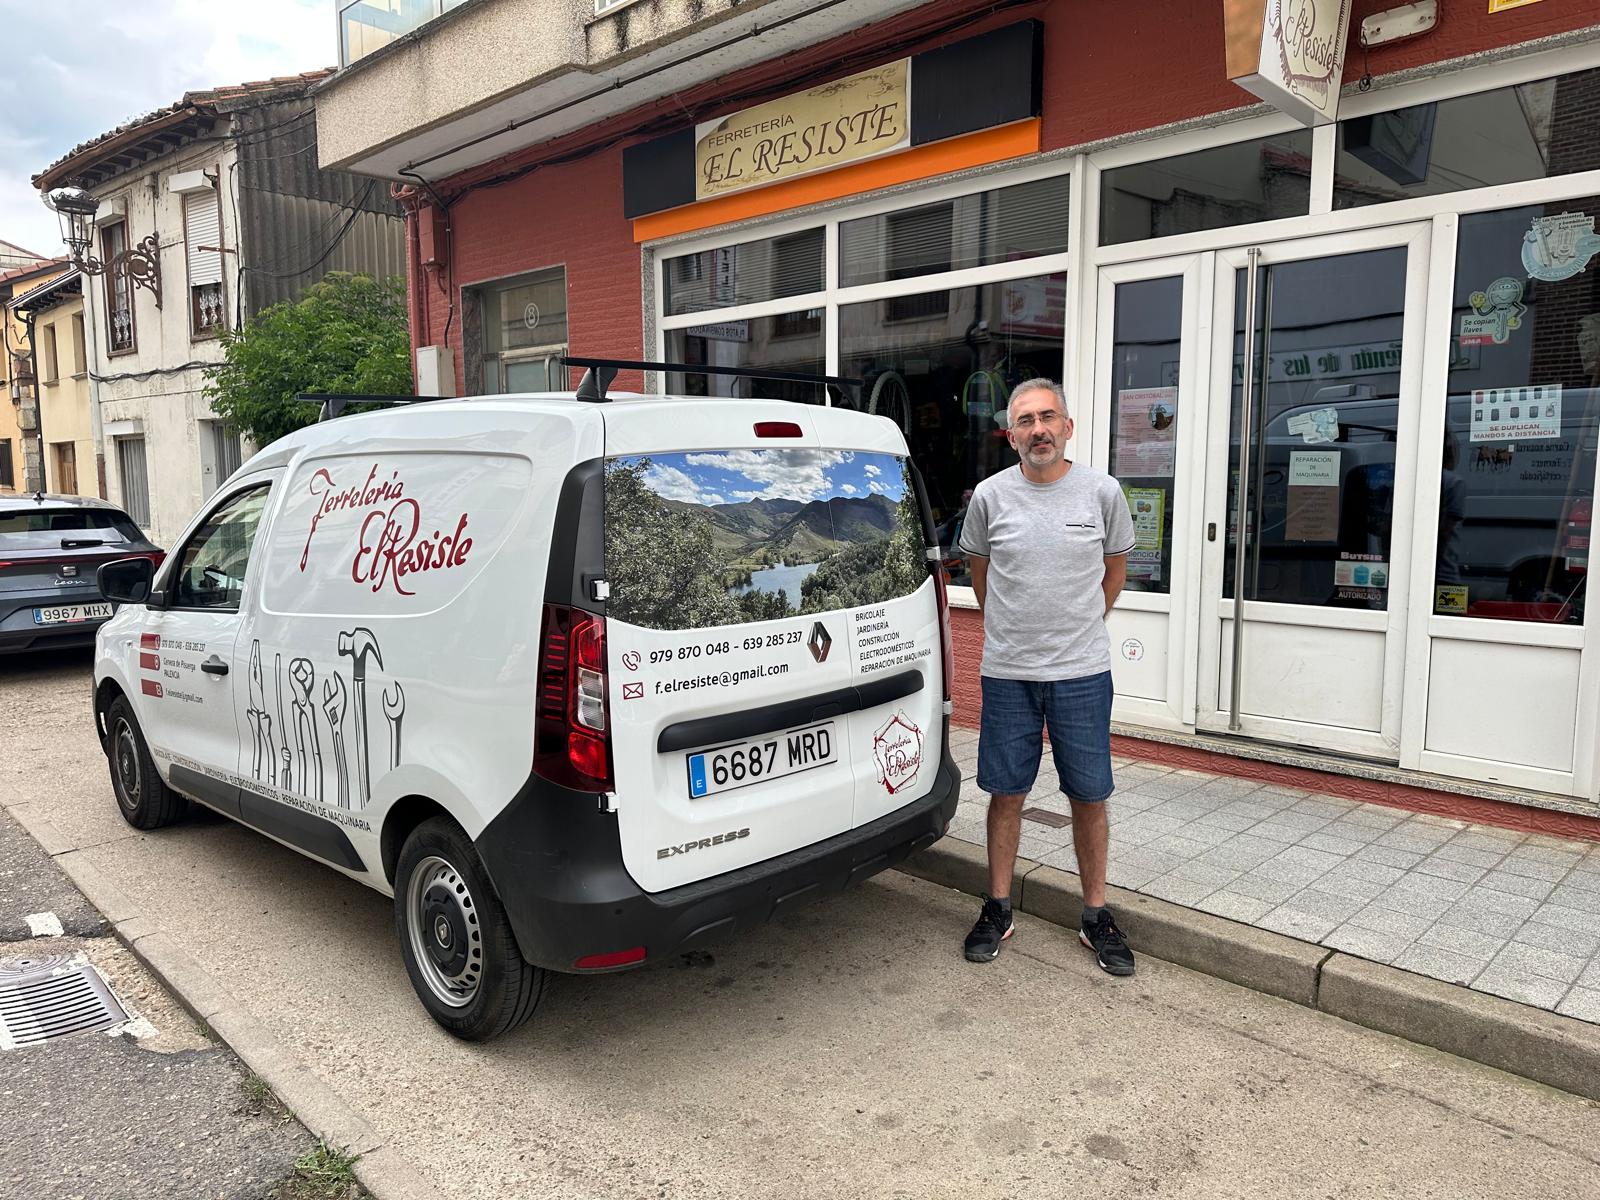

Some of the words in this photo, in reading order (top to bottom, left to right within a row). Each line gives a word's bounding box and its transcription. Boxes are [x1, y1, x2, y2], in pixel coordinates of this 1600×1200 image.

[708, 113, 795, 149] FERRETERÍA
[703, 148, 743, 186] EL
[752, 102, 899, 174] RESISTE
[527, 306, 537, 325] 8
[1473, 318, 1496, 327] copian
[1489, 424, 1500, 432] SE
[1500, 423, 1541, 432] DUPLICAN
[1514, 429, 1557, 437] DISTANCIA
[1295, 455, 1332, 463] REPARACIÓN
[371, 497, 474, 596] Resiste
[54, 578, 88, 587] Leon
[1338, 591, 1382, 601] AUTORIZADO
[43, 607, 79, 621] 9967
[83, 604, 110, 617] MHX
[855, 608, 886, 622] BRICOLAJE
[649, 648, 674, 664] 979
[677, 645, 702, 660] 870
[706, 641, 731, 657] 048
[743, 636, 765, 651] 639
[766, 633, 785, 648] 285
[786, 630, 803, 645] 237
[859, 640, 915, 661] ELECTRODOMÉSTICOS
[896, 655, 904, 665] DE
[903, 647, 932, 663] MAQUINARIA
[163, 670, 181, 680] PALENCIA
[655, 662, 789, 695] f.elresiste@gmail.com
[697, 778, 704, 789] E
[712, 742, 778, 786] 6687
[787, 728, 831, 768] MRD
[281, 792, 318, 815] REPARACIÓN
[317, 806, 329, 818] DE
[328, 808, 373, 833] MAQUINARIA
[656, 827, 751, 861] EXPRESS
